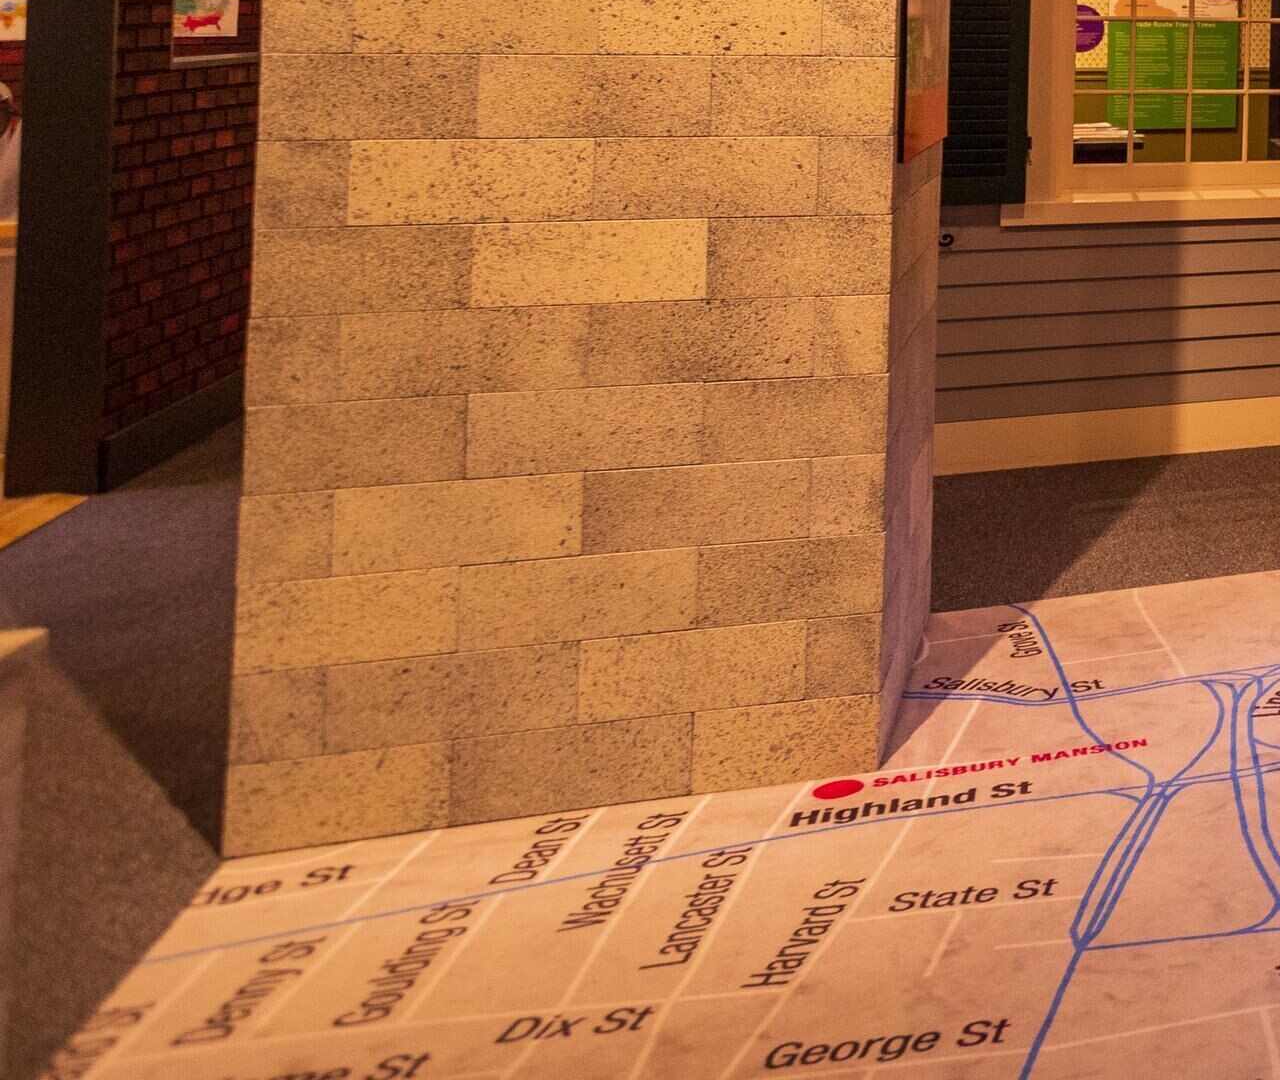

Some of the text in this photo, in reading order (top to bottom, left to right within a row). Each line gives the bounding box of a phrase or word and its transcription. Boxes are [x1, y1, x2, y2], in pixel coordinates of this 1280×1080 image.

[996, 620, 1042, 659] Grove St
[924, 676, 1106, 701] Salisbury St
[872, 737, 1148, 788] SALISBURY MANSION
[788, 780, 1034, 828] Highland St
[489, 814, 591, 886] Dean St
[556, 810, 689, 934] Wachusett St
[300, 864, 358, 888] St
[888, 877, 1060, 913] State St
[638, 845, 753, 971] Lancaster St
[740, 876, 867, 990] Harvard St
[332, 900, 481, 1027] Goulding St
[494, 1005, 655, 1045] Dix St
[764, 1017, 1012, 1070] George St
